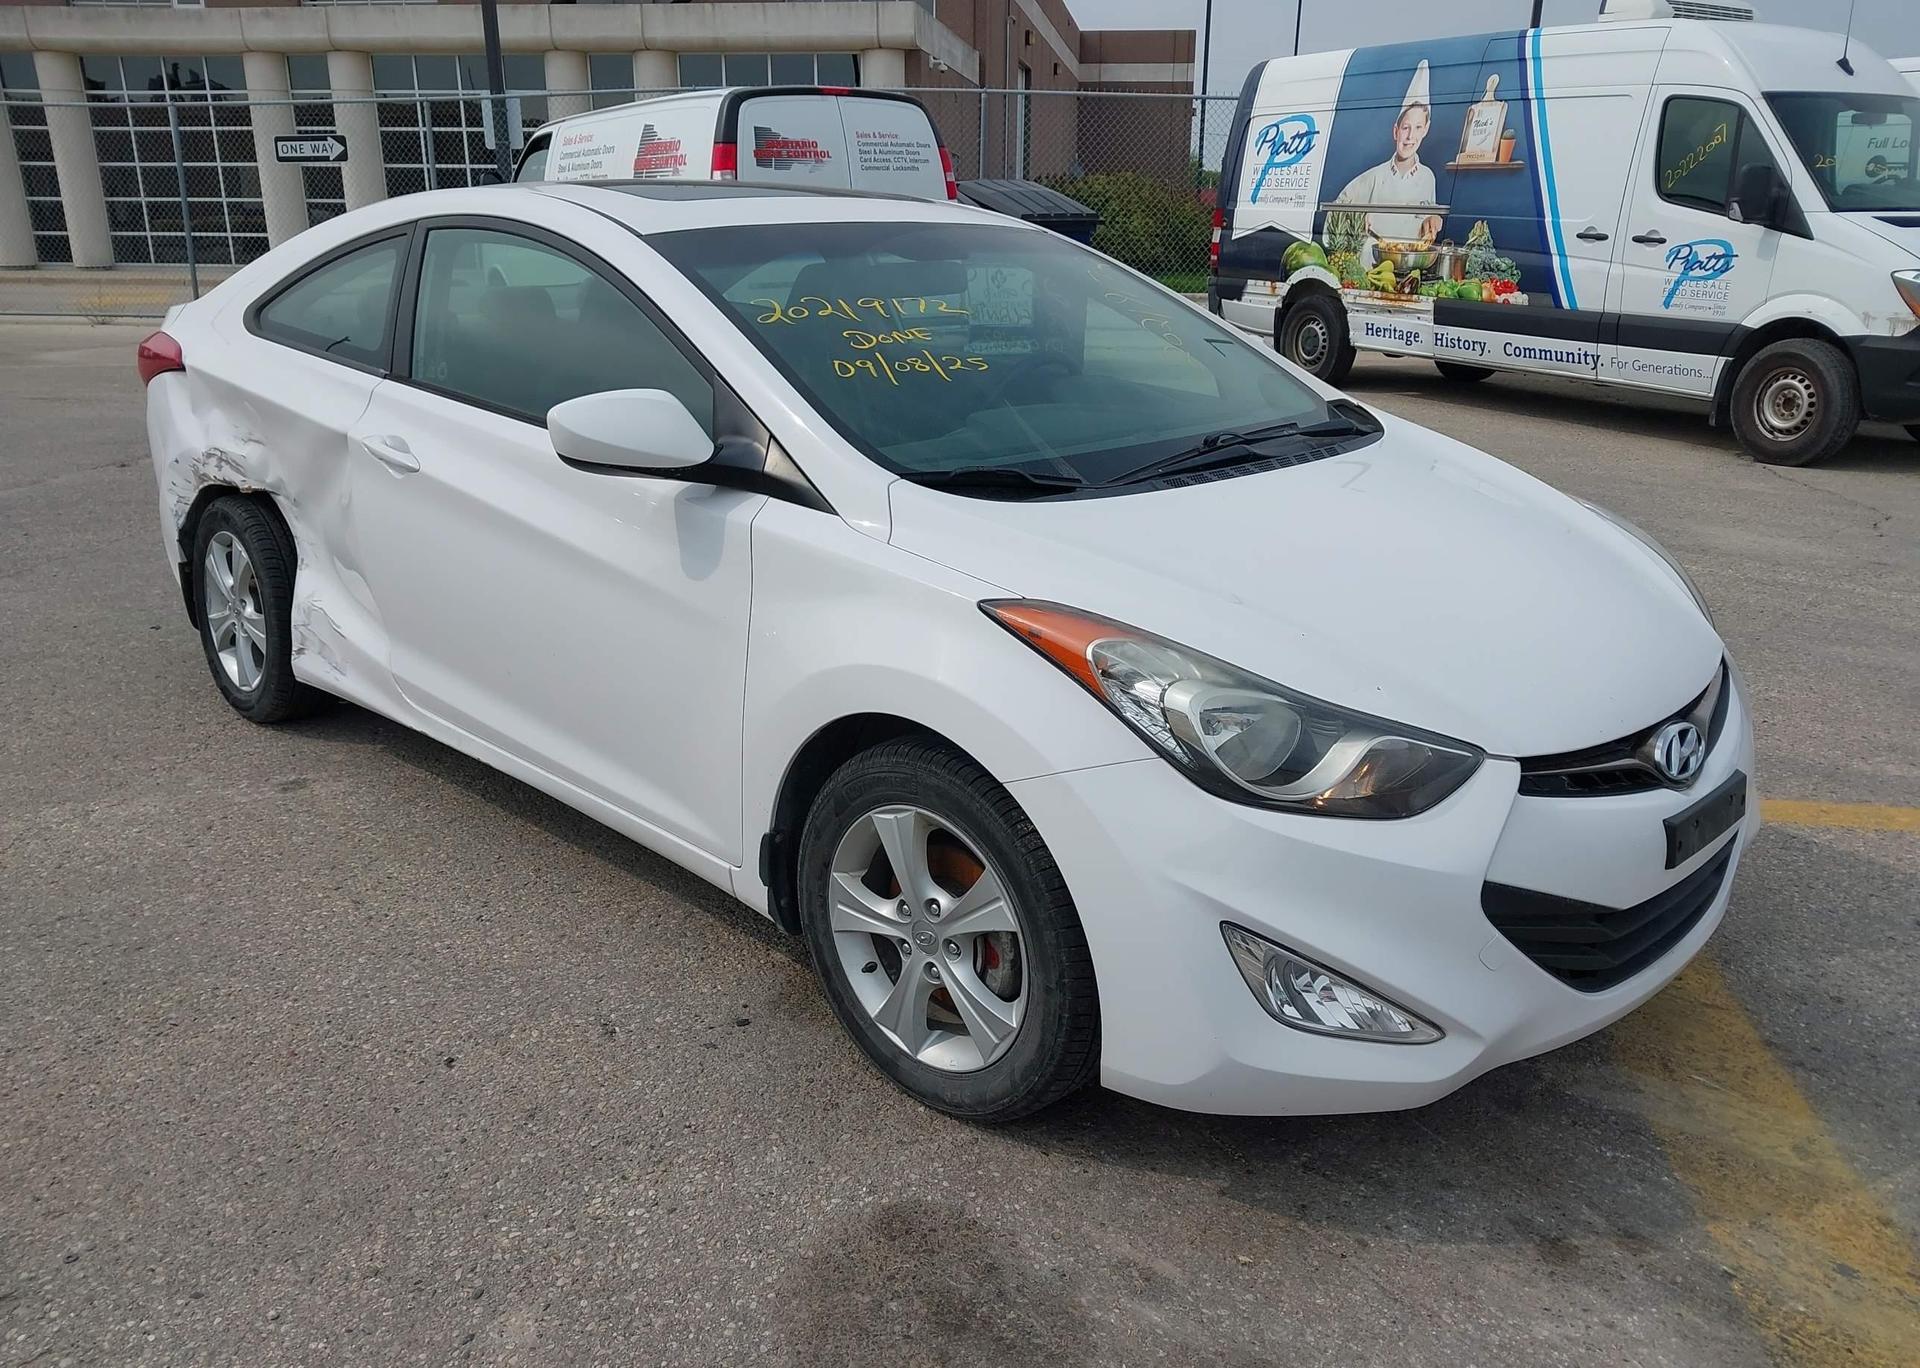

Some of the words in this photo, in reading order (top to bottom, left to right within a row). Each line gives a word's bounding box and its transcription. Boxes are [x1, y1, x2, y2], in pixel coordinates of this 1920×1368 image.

[855, 131, 872, 139] Sales
[281, 143, 305, 155] ONE
[309, 143, 335, 154] WAY
[857, 140, 889, 148] Commercial
[889, 141, 916, 149] Automatic
[916, 141, 931, 149] Doors
[1867, 137, 1890, 149] Full
[1891, 137, 1910, 149] Lo
[905, 149, 921, 157] Doors
[1274, 177, 1310, 188] SERVICE
[1689, 289, 1729, 301] SERVICE
[842, 327, 933, 349] DONE
[1365, 322, 1423, 347] Heritage.
[1433, 332, 1491, 356] History.
[1503, 341, 1605, 370] Community.
[1610, 357, 1629, 370] For
[1631, 359, 1713, 379] Generations...
[832, 349, 990, 387] 09/08/25
